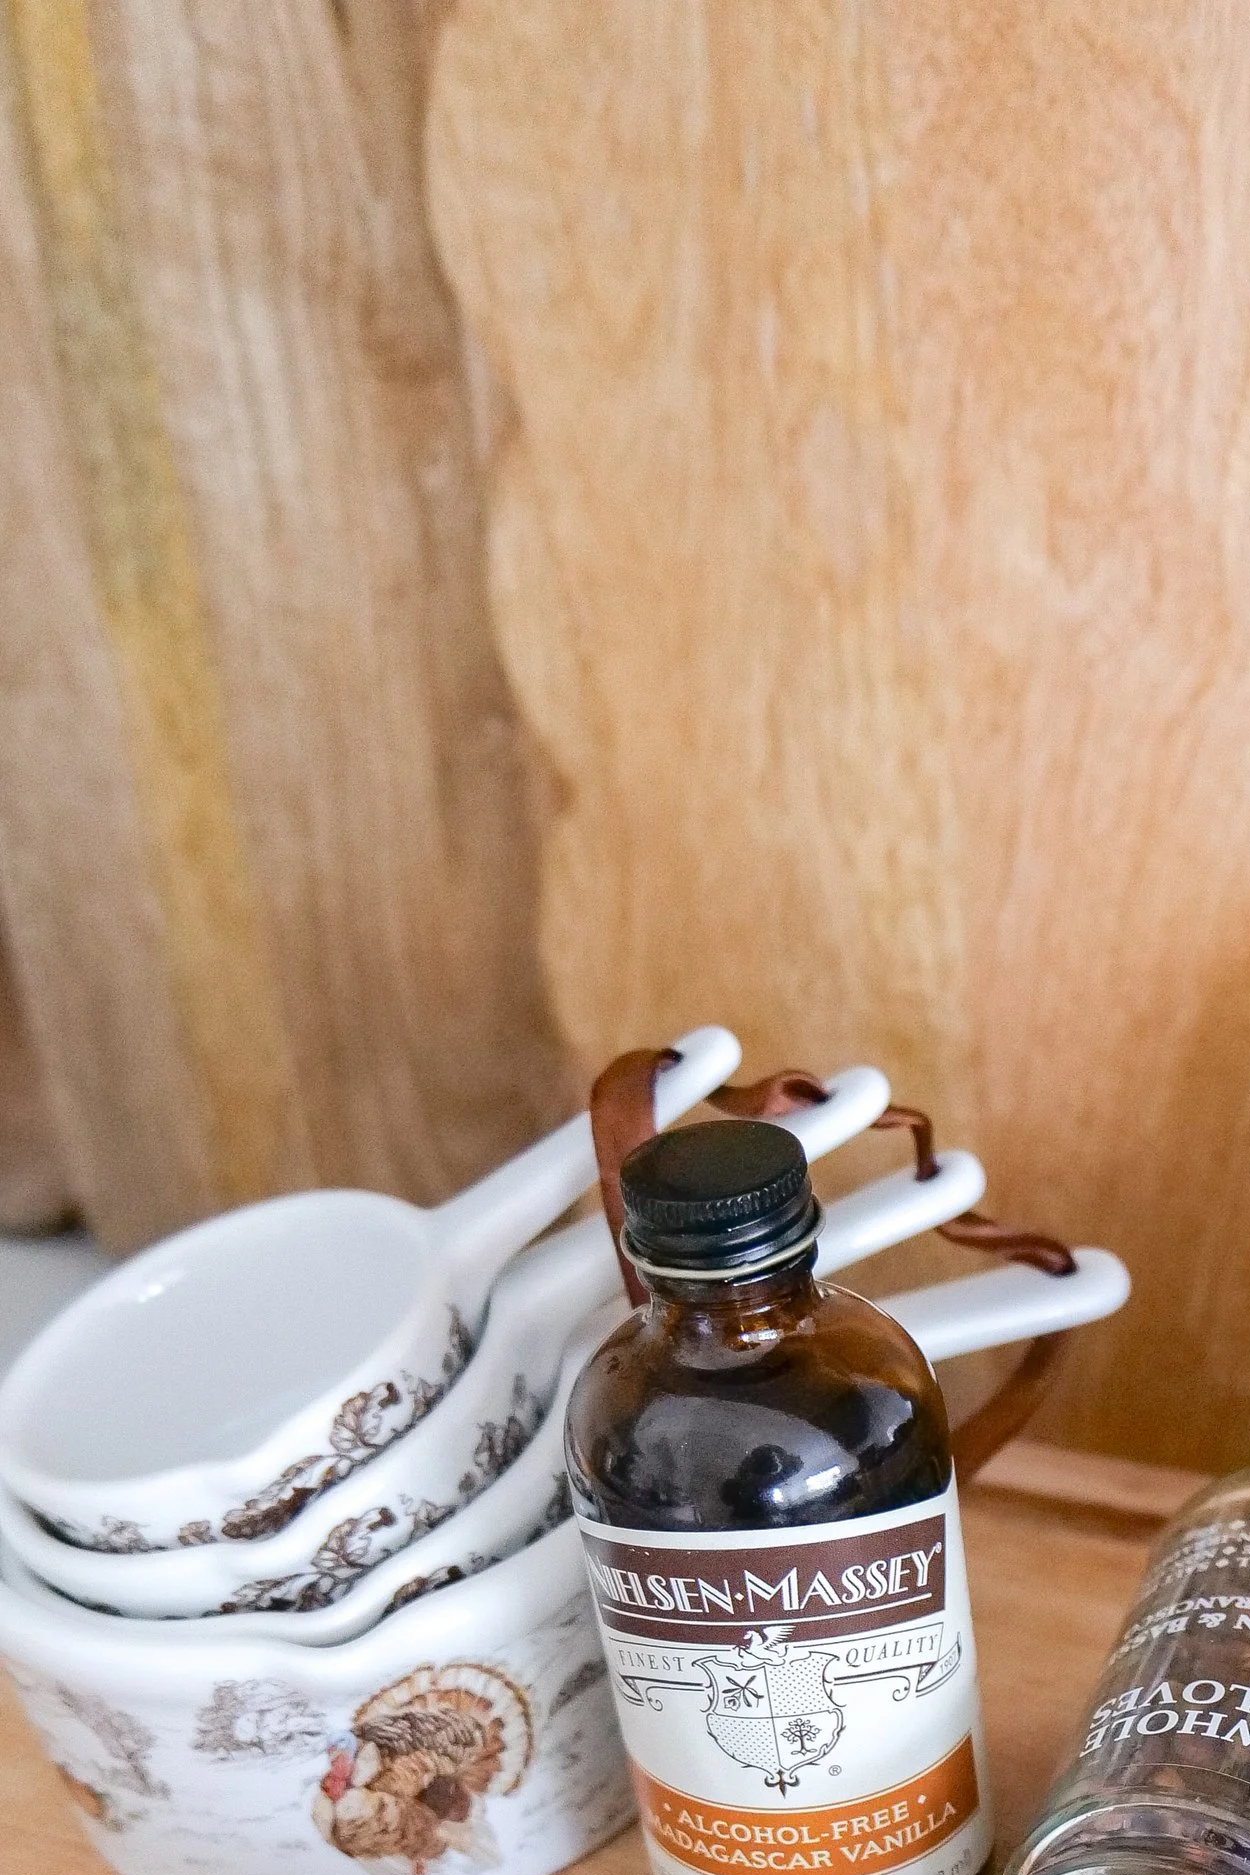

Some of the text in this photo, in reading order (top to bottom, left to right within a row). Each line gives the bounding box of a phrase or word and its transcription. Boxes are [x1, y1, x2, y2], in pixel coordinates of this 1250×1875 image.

[1197, 1612, 1227, 1628] &
[618, 1634, 938, 1672] FINEST QUALITY
[677, 1801, 910, 1846] ALCOHOL-FREE
[839, 1801, 957, 1864] VANILLA
